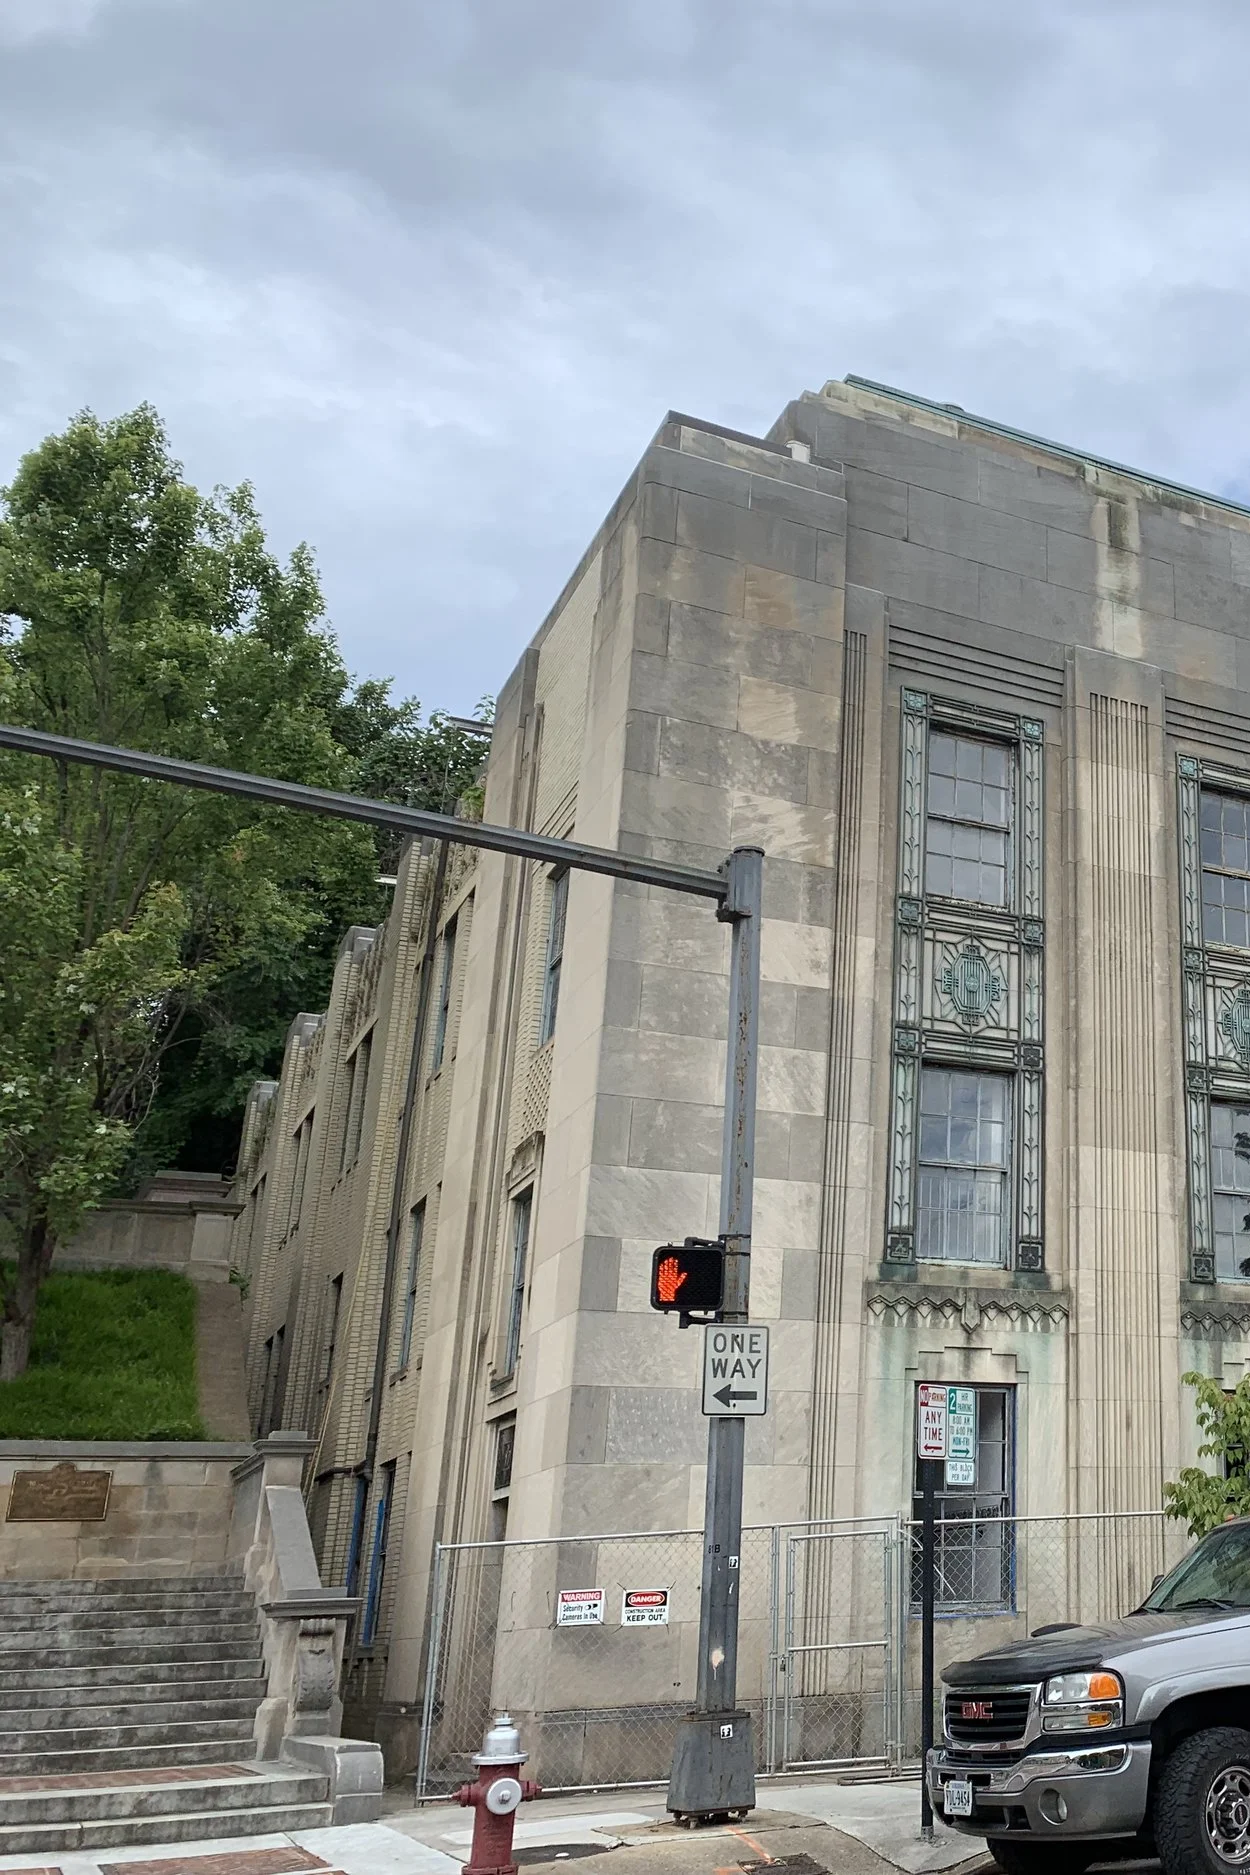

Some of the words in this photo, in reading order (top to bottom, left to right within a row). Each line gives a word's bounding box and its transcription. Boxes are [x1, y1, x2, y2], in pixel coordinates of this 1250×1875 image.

[713, 1333, 761, 1353] ONE
[711, 1358, 762, 1378] WAY
[920, 1390, 928, 1403] NO
[928, 1393, 946, 1403] PARKING
[949, 1392, 956, 1411] 2
[925, 1411, 942, 1425] ANY
[924, 1427, 943, 1441] TIME
[563, 1592, 601, 1602] WARNING
[630, 1595, 662, 1603] DANGER
[563, 1604, 583, 1613] Security
[562, 1613, 582, 1621] Cameras
[626, 1614, 646, 1622] KEEP
[962, 1702, 994, 1719] GMC
